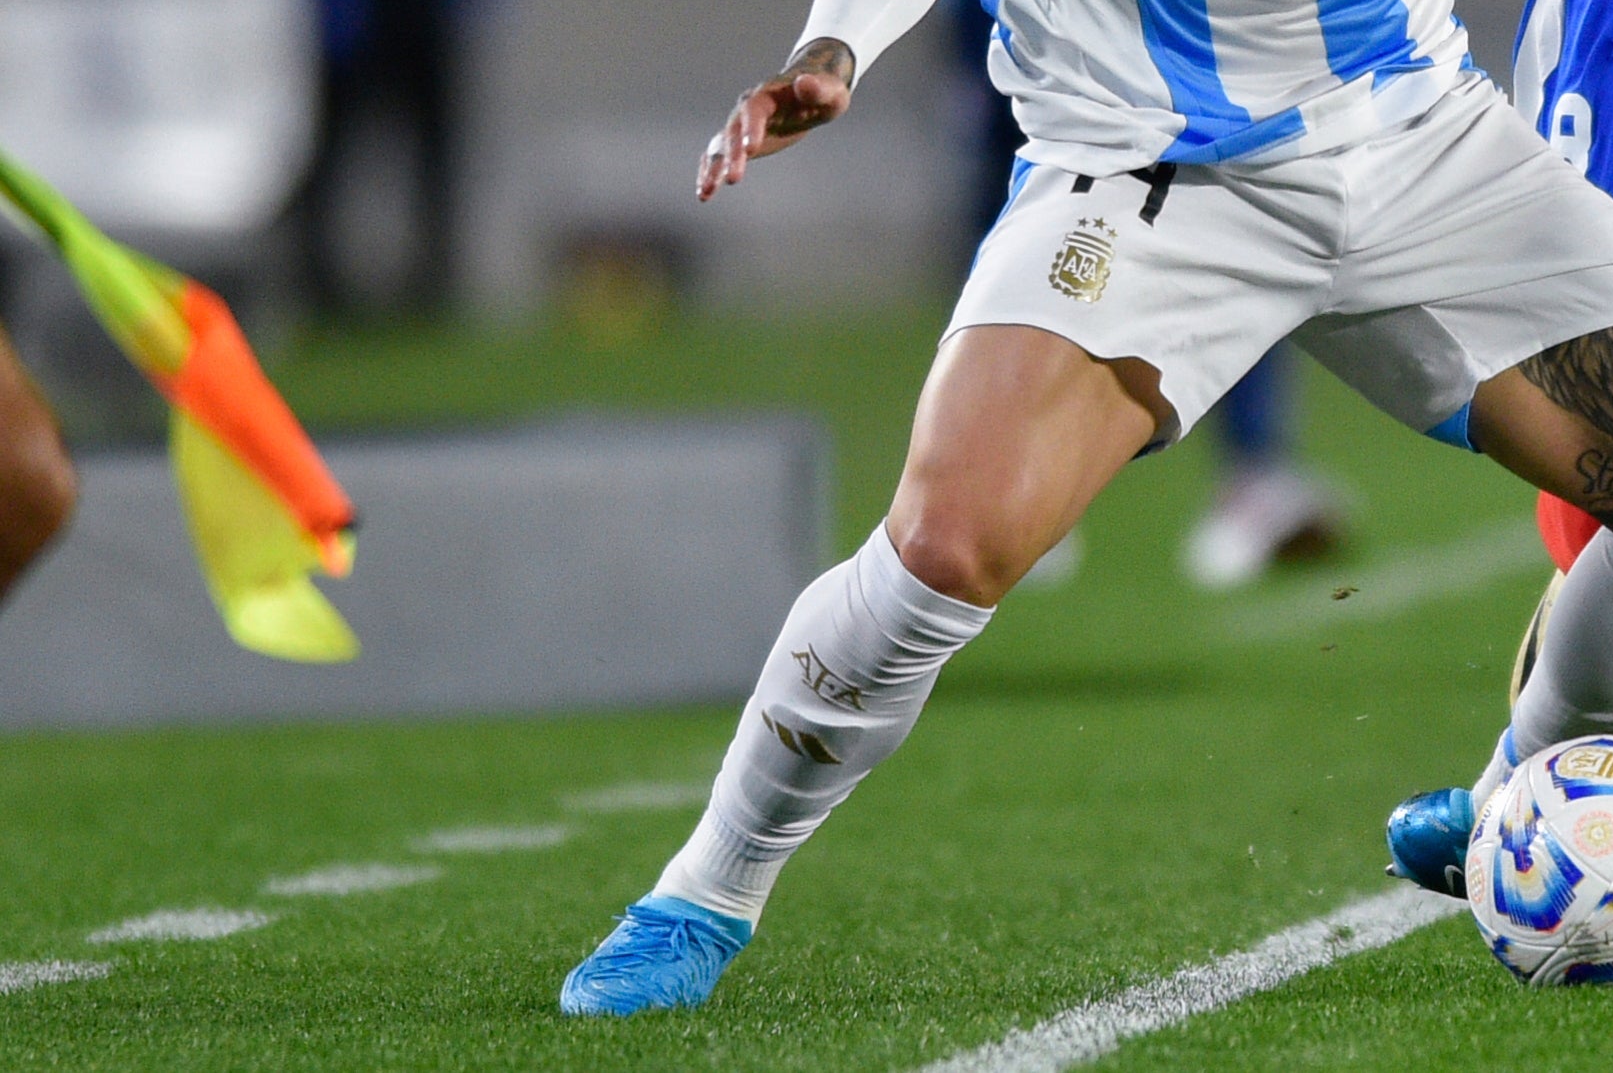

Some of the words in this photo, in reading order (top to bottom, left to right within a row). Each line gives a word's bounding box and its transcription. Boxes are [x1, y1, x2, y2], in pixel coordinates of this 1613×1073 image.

[1070, 161, 1177, 227] 4
[1063, 248, 1099, 284] AFA
[791, 642, 868, 715] AFA
